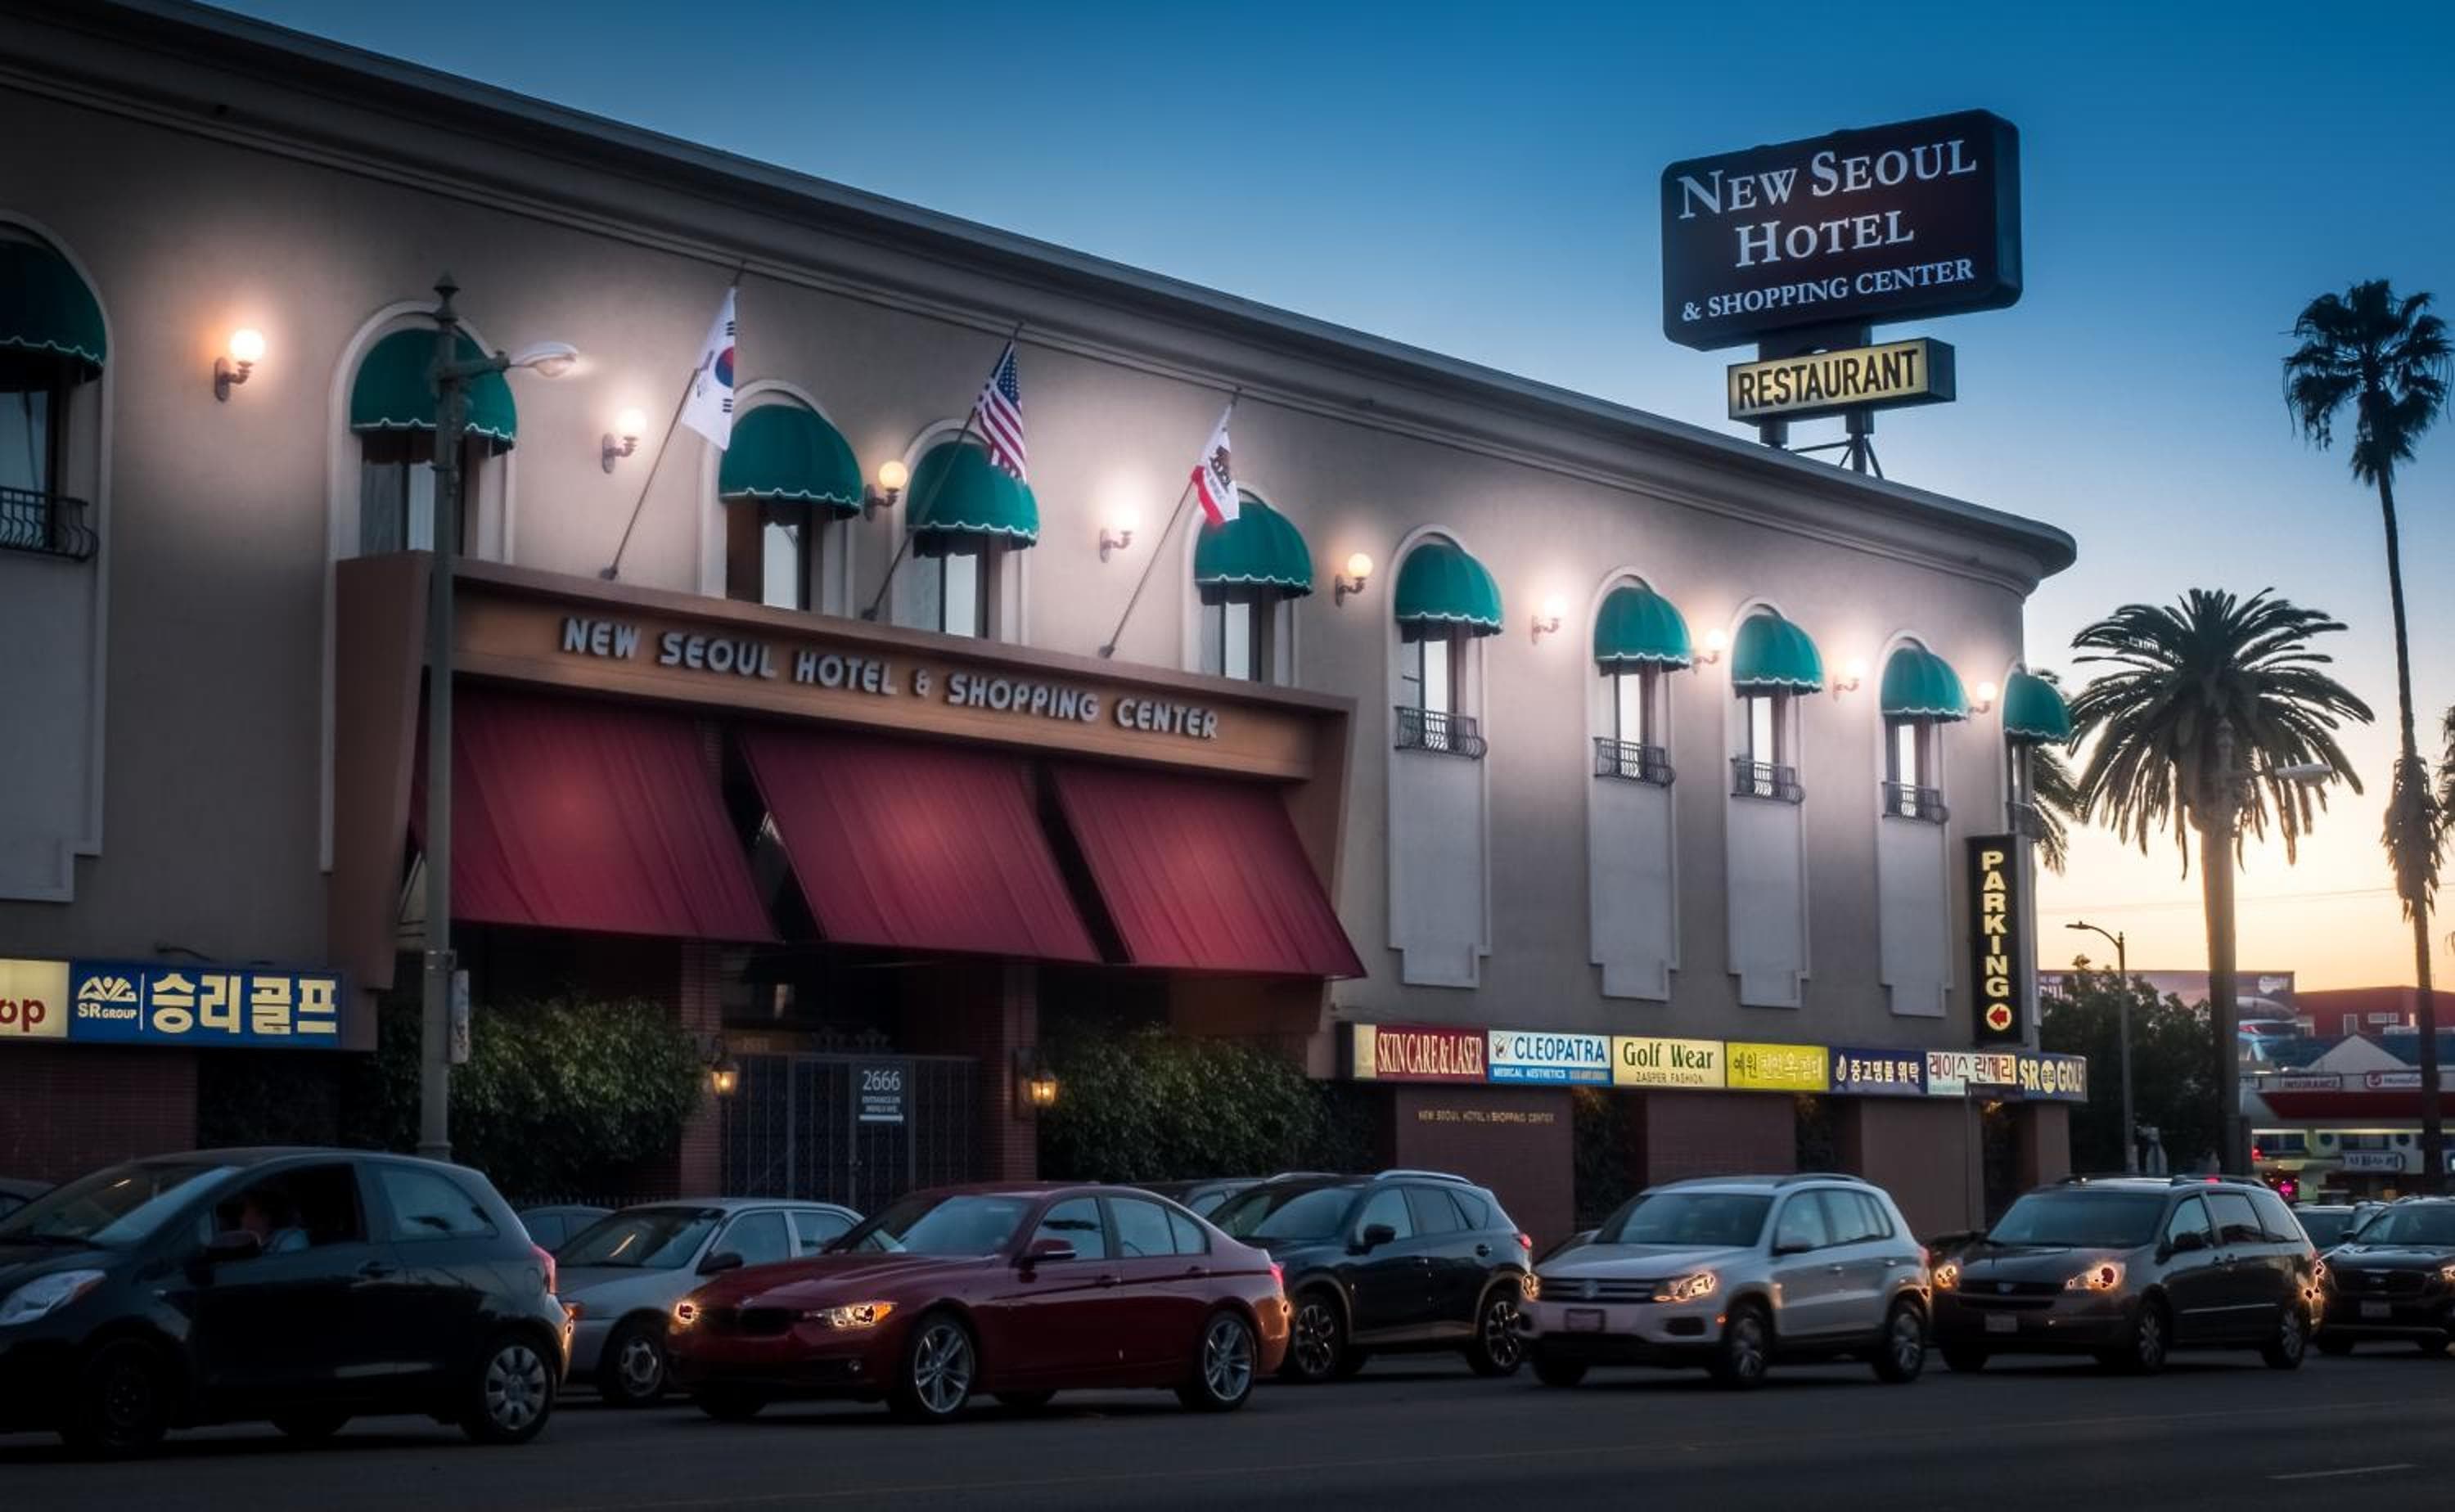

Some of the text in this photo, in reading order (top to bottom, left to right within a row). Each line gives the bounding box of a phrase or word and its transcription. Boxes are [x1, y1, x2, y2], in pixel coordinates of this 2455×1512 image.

[1678, 140, 1976, 218] NEW SEOUL
[1734, 210, 1914, 268] HOTEL
[1682, 259, 1975, 322] & SHOPPING CENTER
[1737, 349, 1919, 410] RESTAURANT
[563, 616, 1218, 740] NEW SEOUL HOTEL & SHOPPING CENTER
[1981, 851, 2010, 997] PARKING
[79, 1002, 137, 1019] SR GROUP
[152, 973, 336, 1034] 승리골프
[1378, 1032, 1484, 1074] SKIN CARE & LASER
[1515, 1036, 1606, 1062] CLEOPATRA
[1623, 1042, 1714, 1069] Golf Wear
[1930, 1054, 1970, 1081] 레이스
[863, 1069, 901, 1091] 2666
[2019, 1058, 2041, 1091] SR
